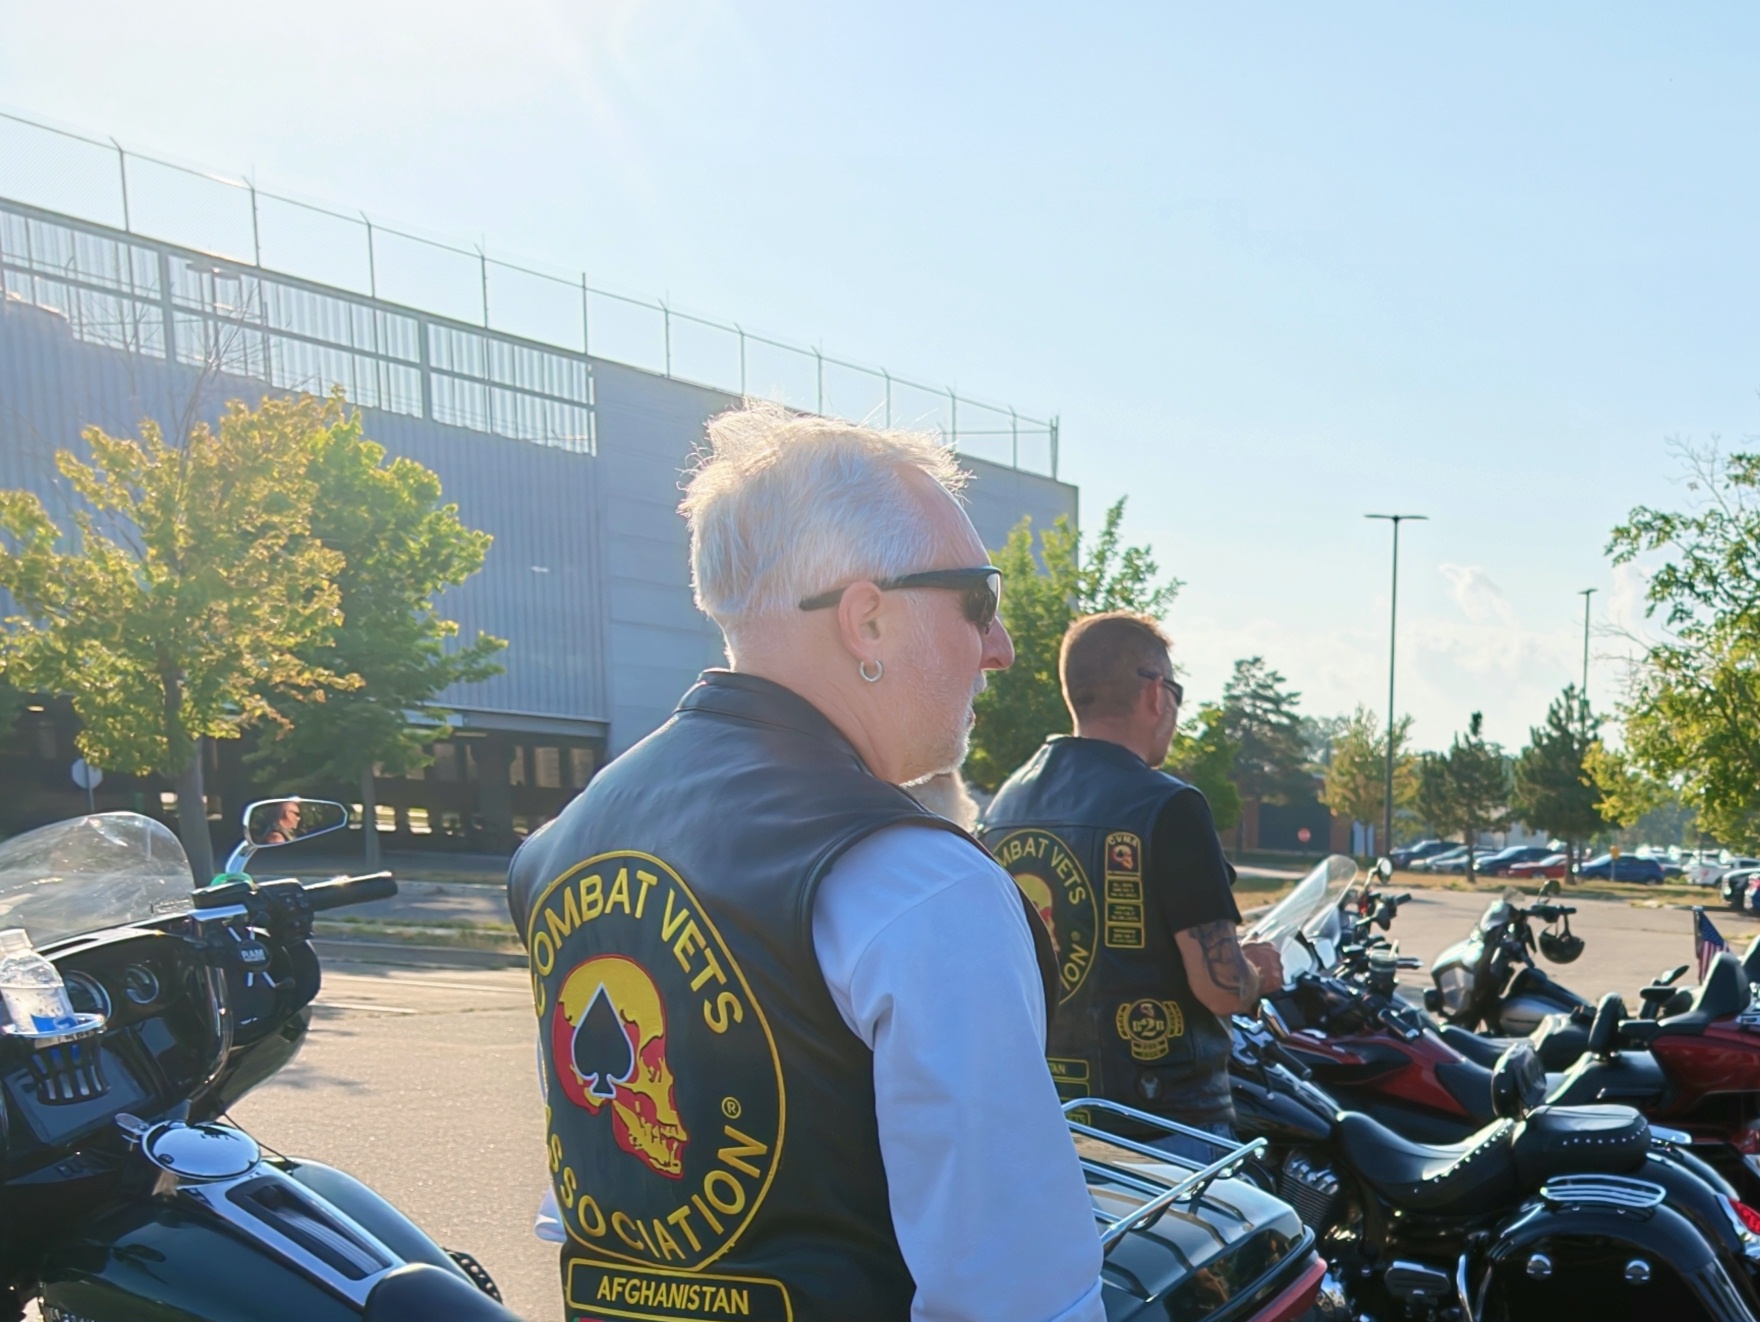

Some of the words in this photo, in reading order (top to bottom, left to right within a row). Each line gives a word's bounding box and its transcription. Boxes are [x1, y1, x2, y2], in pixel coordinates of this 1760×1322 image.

[996, 837, 1050, 868] MBAT
[1050, 846, 1087, 904] VETS
[533, 867, 658, 1018] COMBAT
[661, 887, 744, 1034] VETS
[596, 1275, 750, 1316] AFGHANISTAN
